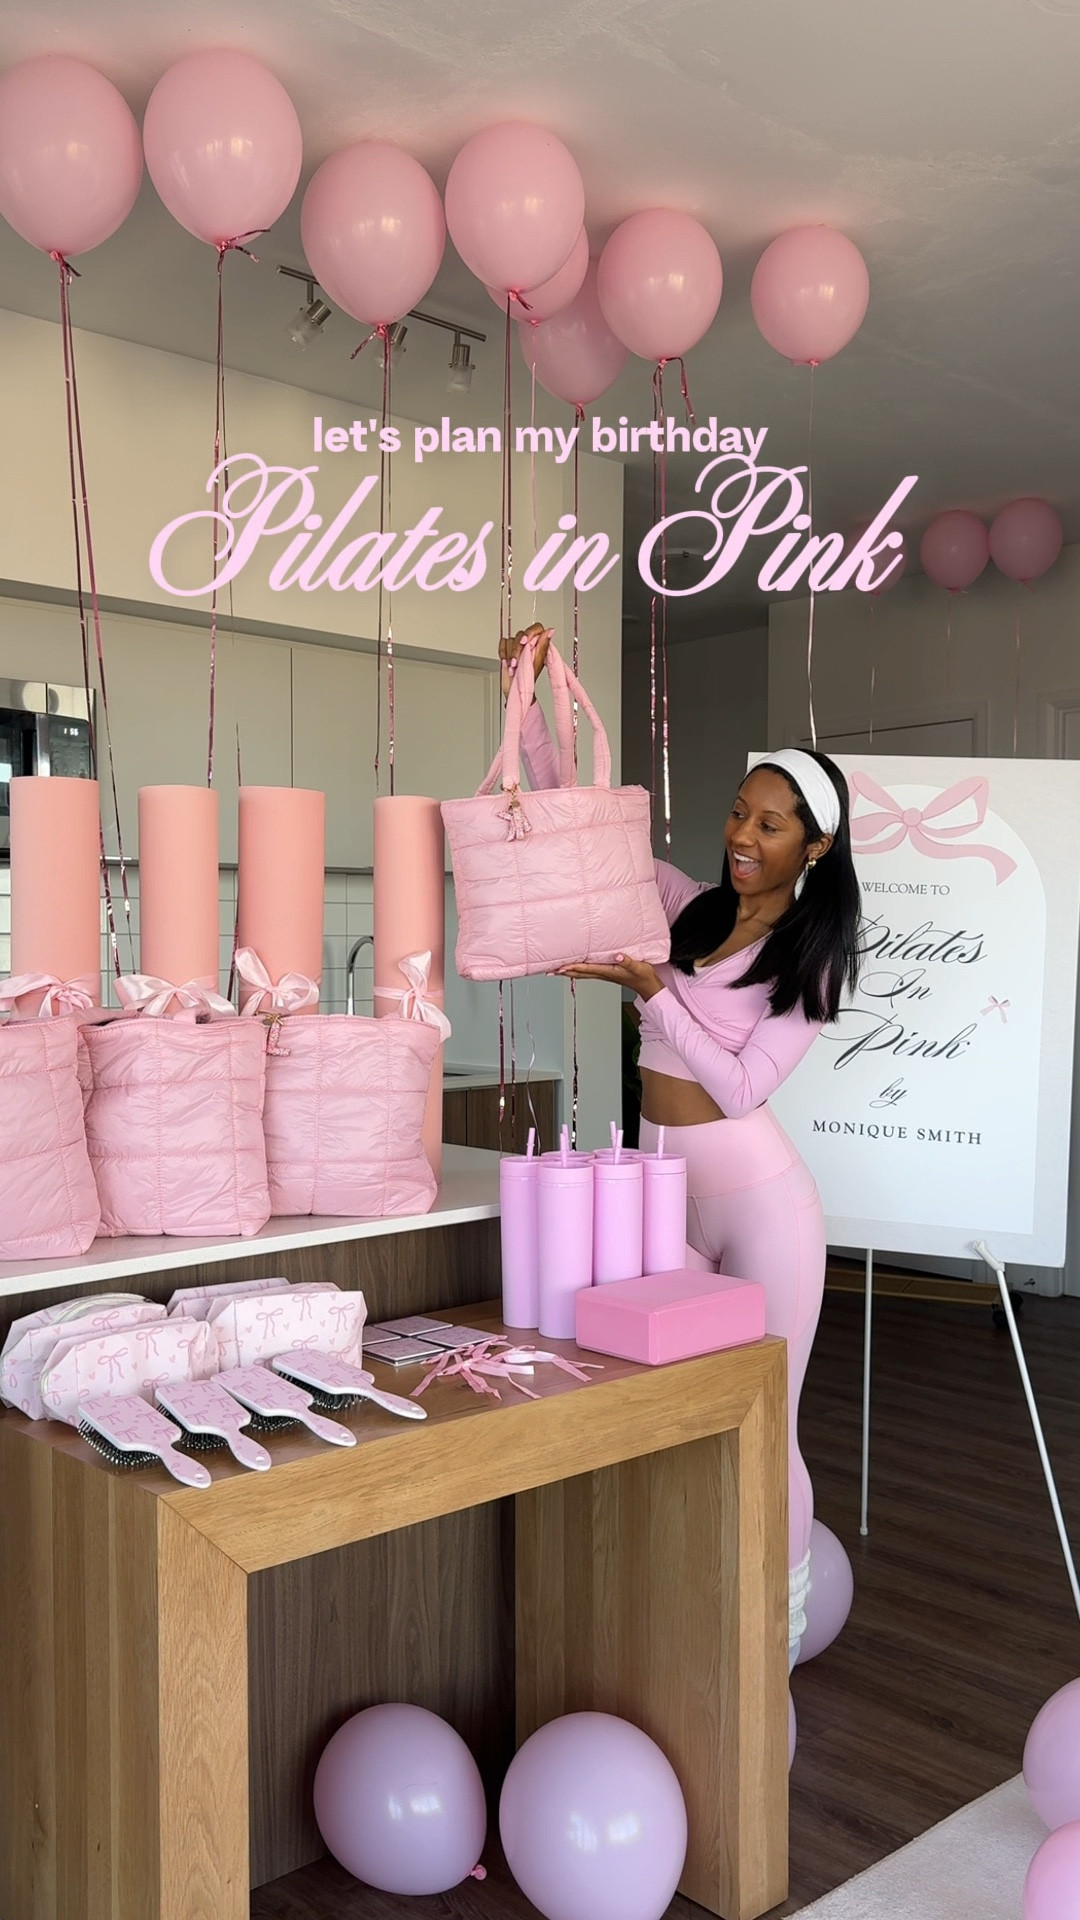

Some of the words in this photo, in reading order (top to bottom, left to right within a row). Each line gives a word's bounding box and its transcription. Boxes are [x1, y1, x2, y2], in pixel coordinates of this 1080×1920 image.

[861, 882, 928, 895] WELCOME
[930, 885, 951, 896] TO
[858, 968, 934, 1009] In
[819, 1008, 978, 1070] Pink
[868, 1077, 908, 1108] by
[812, 1119, 908, 1139] MONIQUE
[916, 1128, 982, 1145] SMITH
